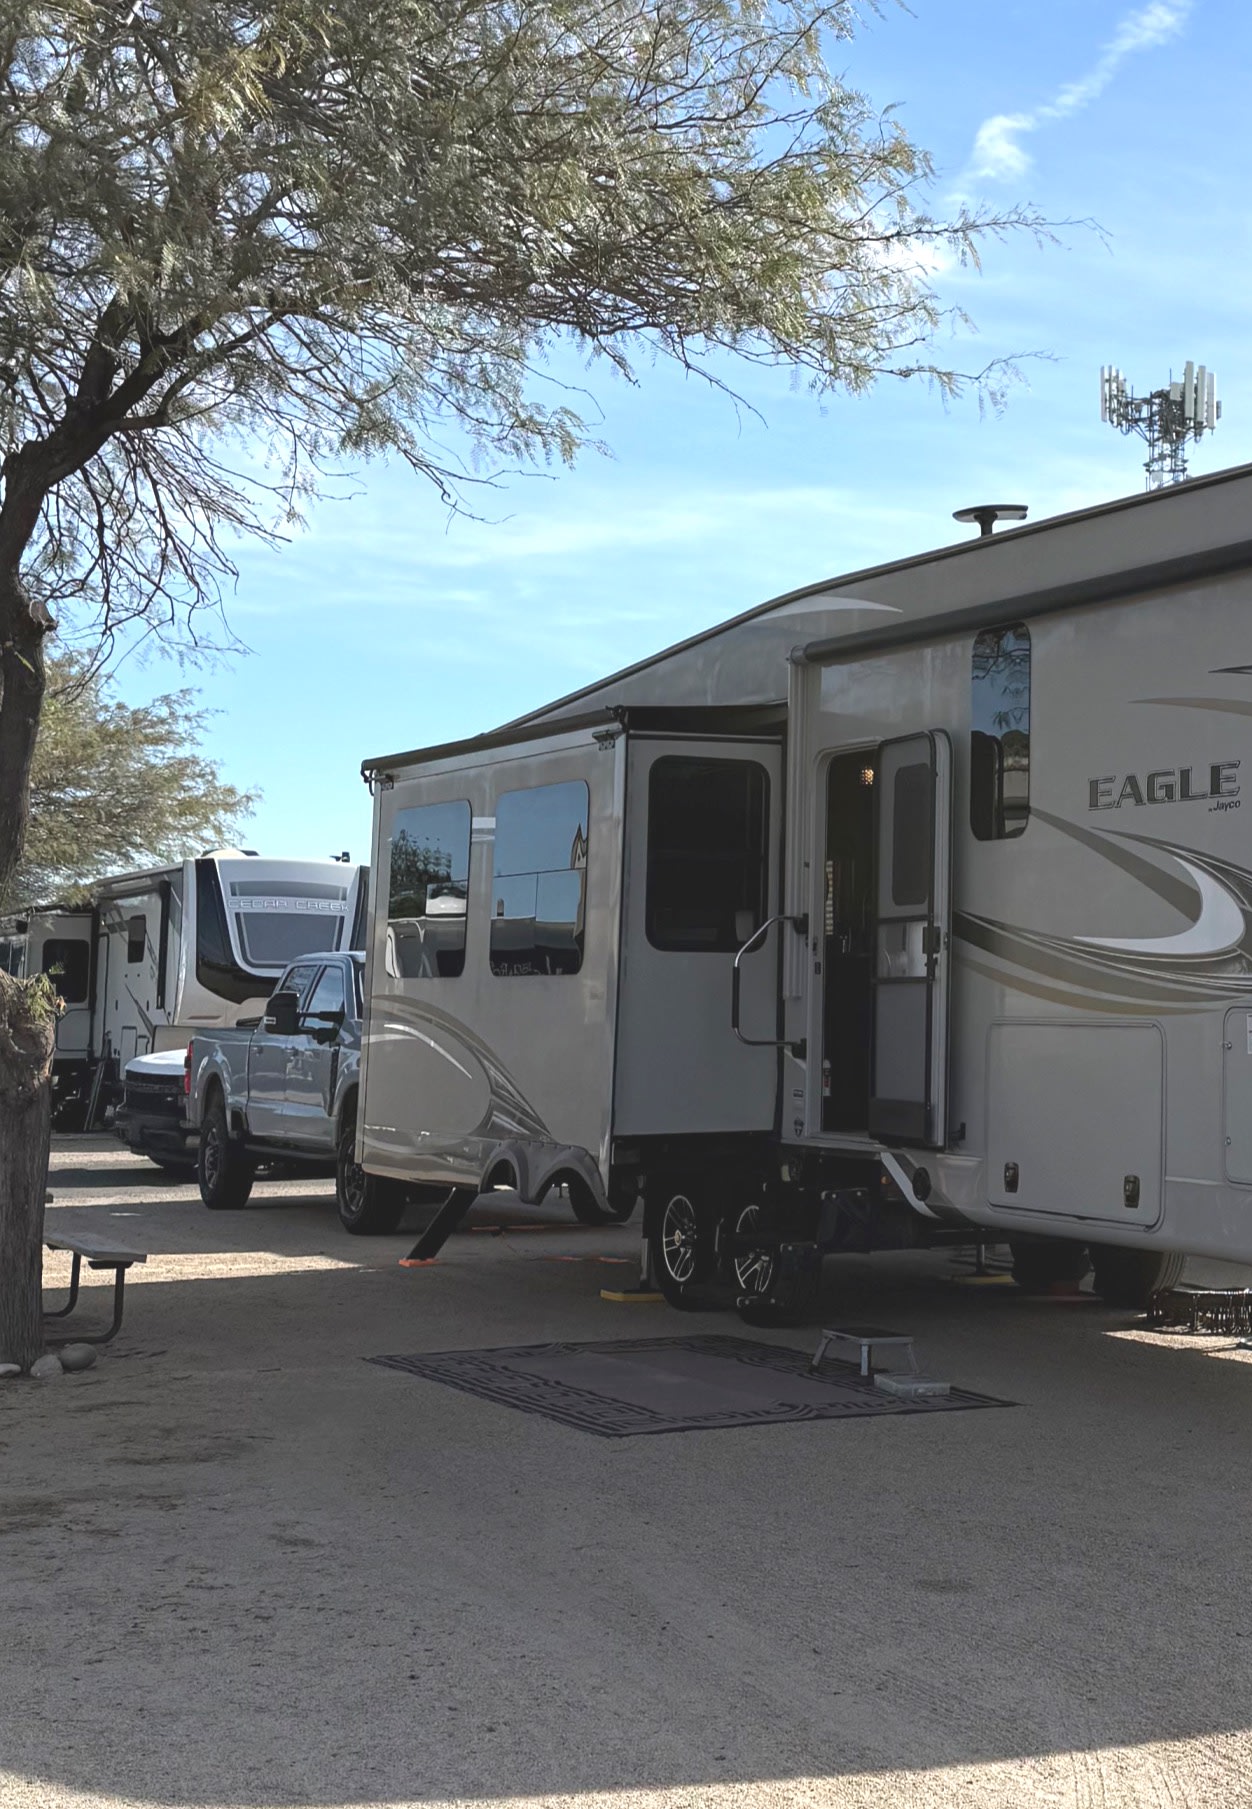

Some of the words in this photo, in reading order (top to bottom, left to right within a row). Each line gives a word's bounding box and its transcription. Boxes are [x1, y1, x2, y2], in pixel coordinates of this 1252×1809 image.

[1088, 760, 1241, 811] EAGLE
[1213, 800, 1241, 812] Jayco
[228, 899, 288, 909] CEDAR
[296, 900, 349, 912] CREEK
